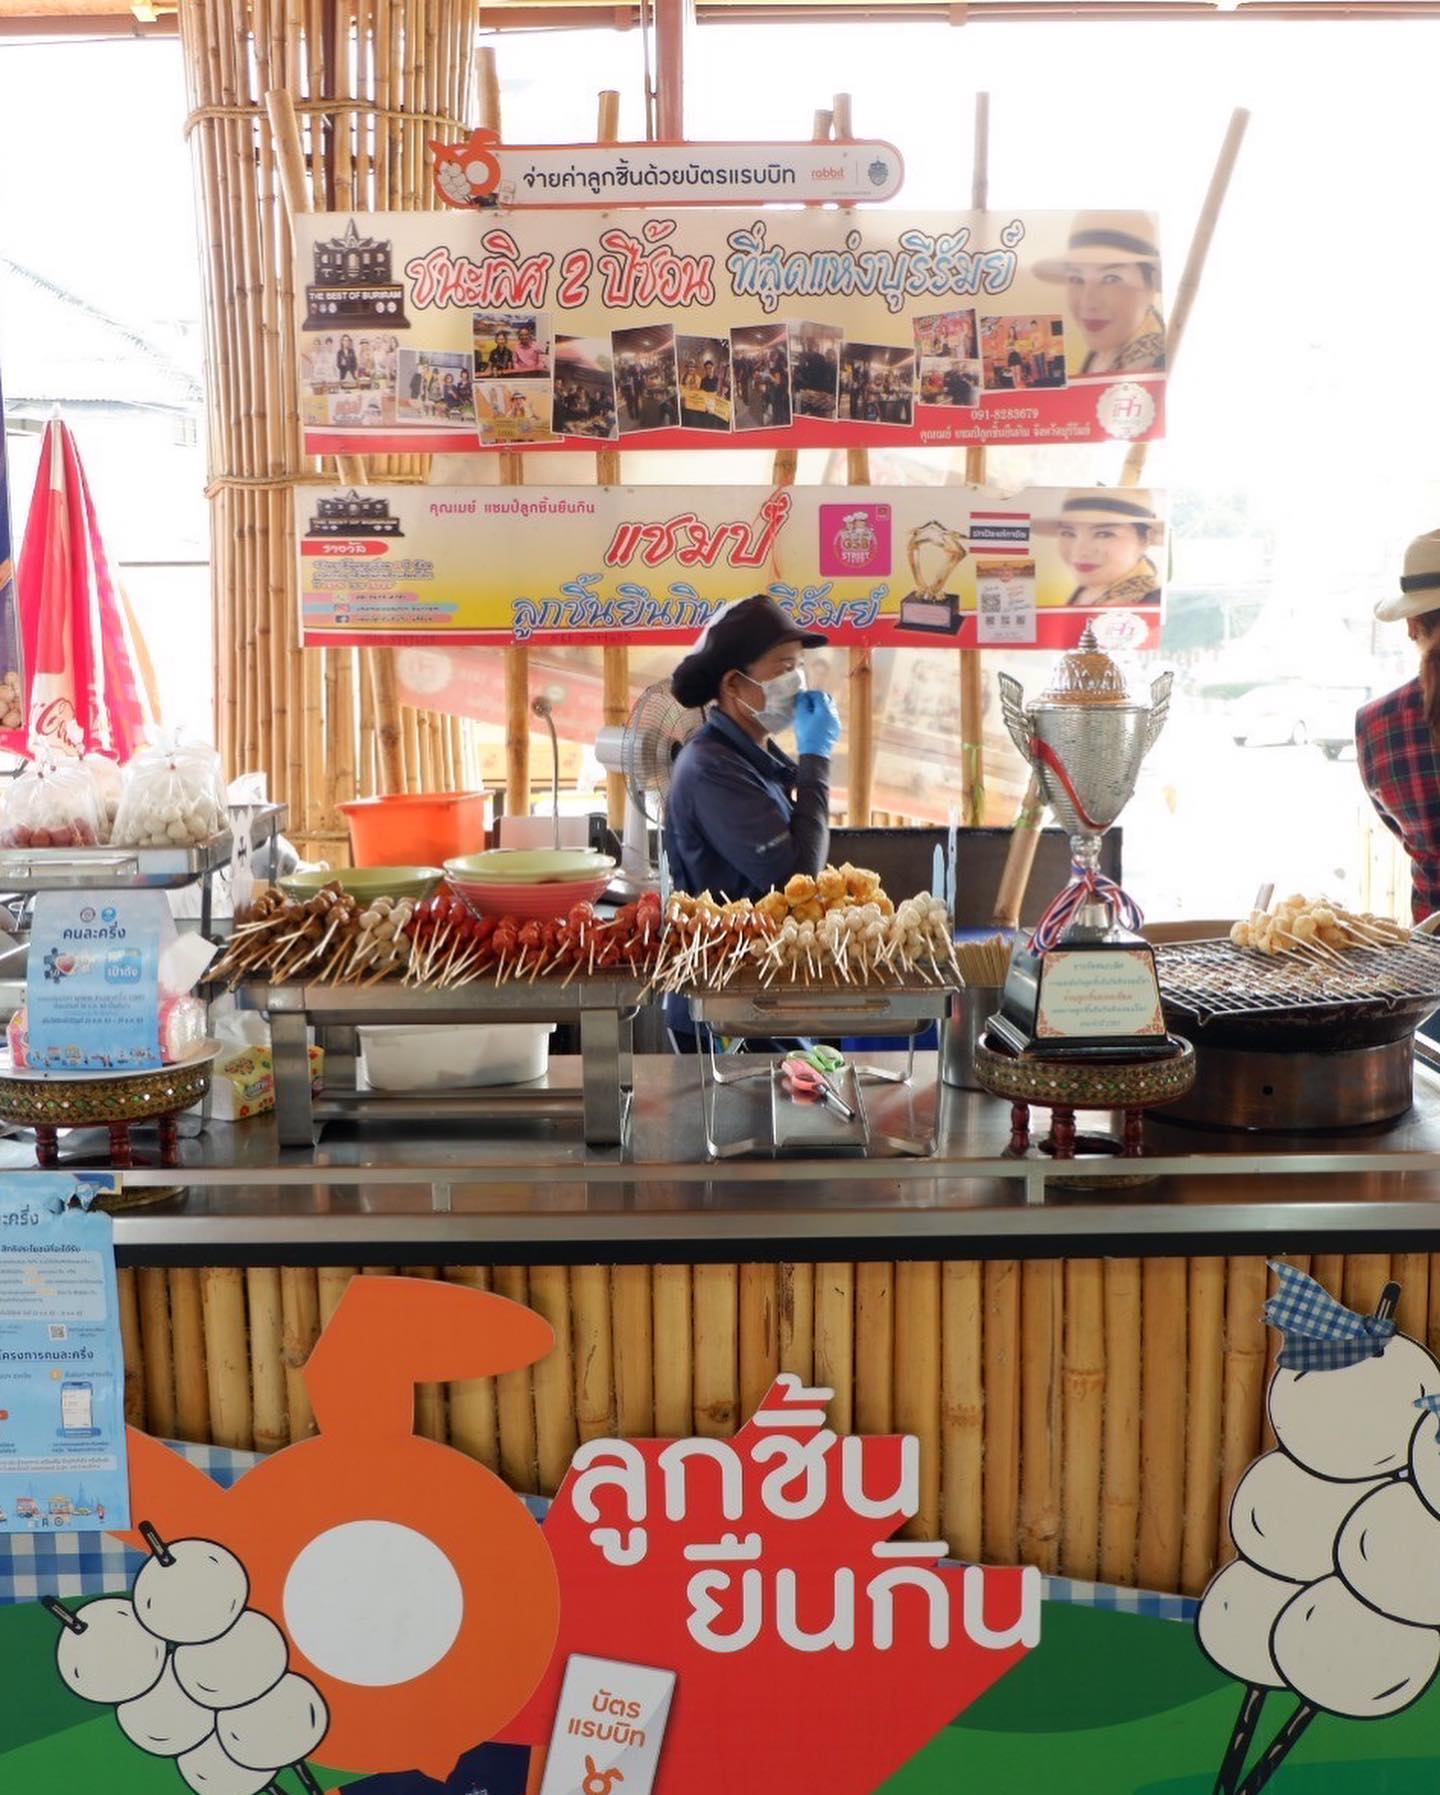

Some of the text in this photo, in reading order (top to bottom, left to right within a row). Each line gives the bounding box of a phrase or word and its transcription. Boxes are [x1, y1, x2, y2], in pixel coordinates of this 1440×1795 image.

[523, 158, 796, 194] จ่ายค่าลูกชิ้นด้วยบัตรแรบบิท
[811, 167, 845, 179] rabbit
[404, 219, 1026, 314] ชนะเลิศ 2 ปีซ้อน ที่สุดแห่งบุรีรัมย์
[309, 292, 324, 301] THE
[325, 292, 347, 300] BEST
[348, 291, 361, 300] OF
[430, 499, 477, 516] คุณเมย์
[604, 492, 792, 569] แชมป์
[63, 921, 127, 940] คนละครึ่ง
[0, 1205, 40, 1226] ะครึ่ง
[571, 1372, 921, 1567] ลูกชิ้น
[683, 1531, 1042, 1653] ยืนกิน
[592, 1688, 642, 1719] บัตร
[568, 1717, 646, 1748] แรบบิท
